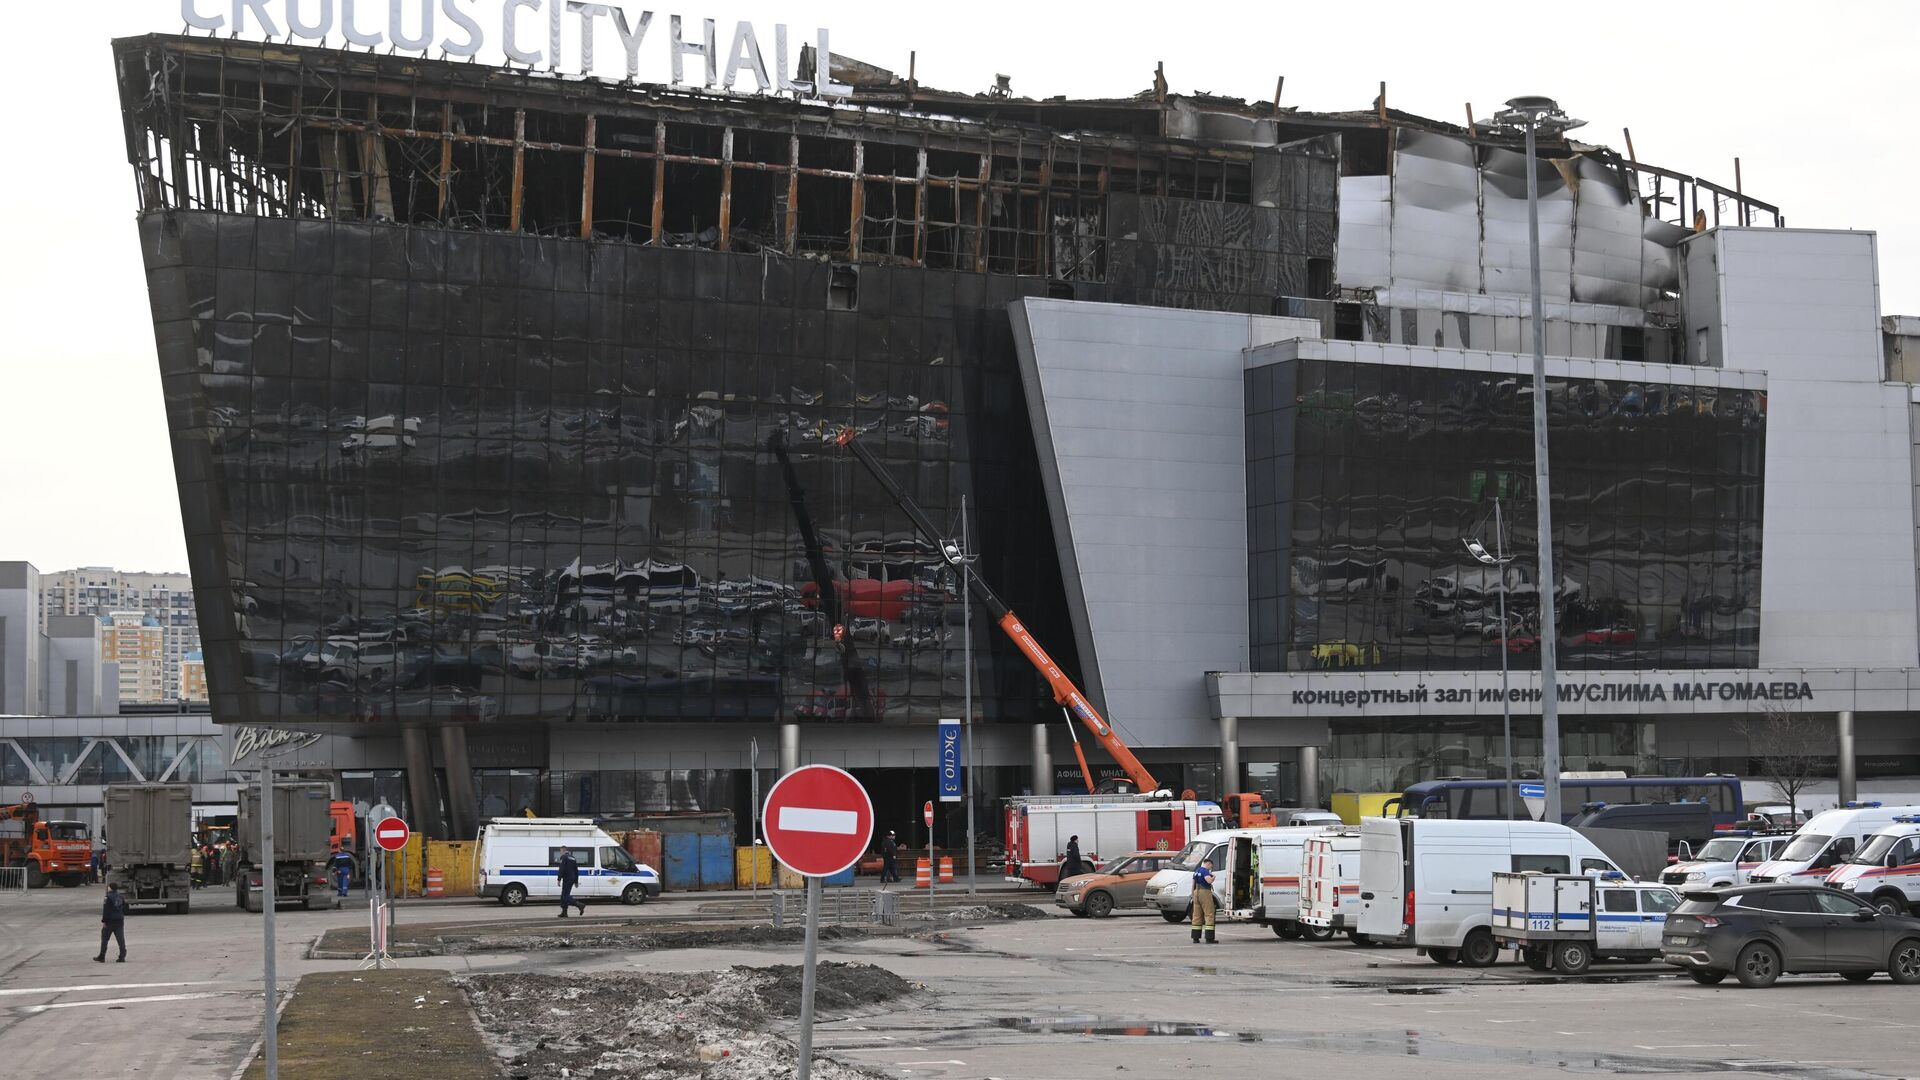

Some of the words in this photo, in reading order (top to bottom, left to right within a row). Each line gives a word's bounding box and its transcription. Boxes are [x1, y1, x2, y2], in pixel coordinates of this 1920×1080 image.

[502, 0, 653, 78] CITY
[669, 14, 854, 97] HALL
[1292, 684, 1428, 708] концертный
[1434, 688, 1471, 702] зал
[1556, 683, 1666, 702] МУСЛИМА
[1673, 682, 1813, 701] МАГОМАЕВА
[945, 729, 957, 778] ЭКСПО
[1100, 769, 1124, 777] WHAT
[945, 783, 958, 792] 3
[1532, 919, 1550, 930] 112
